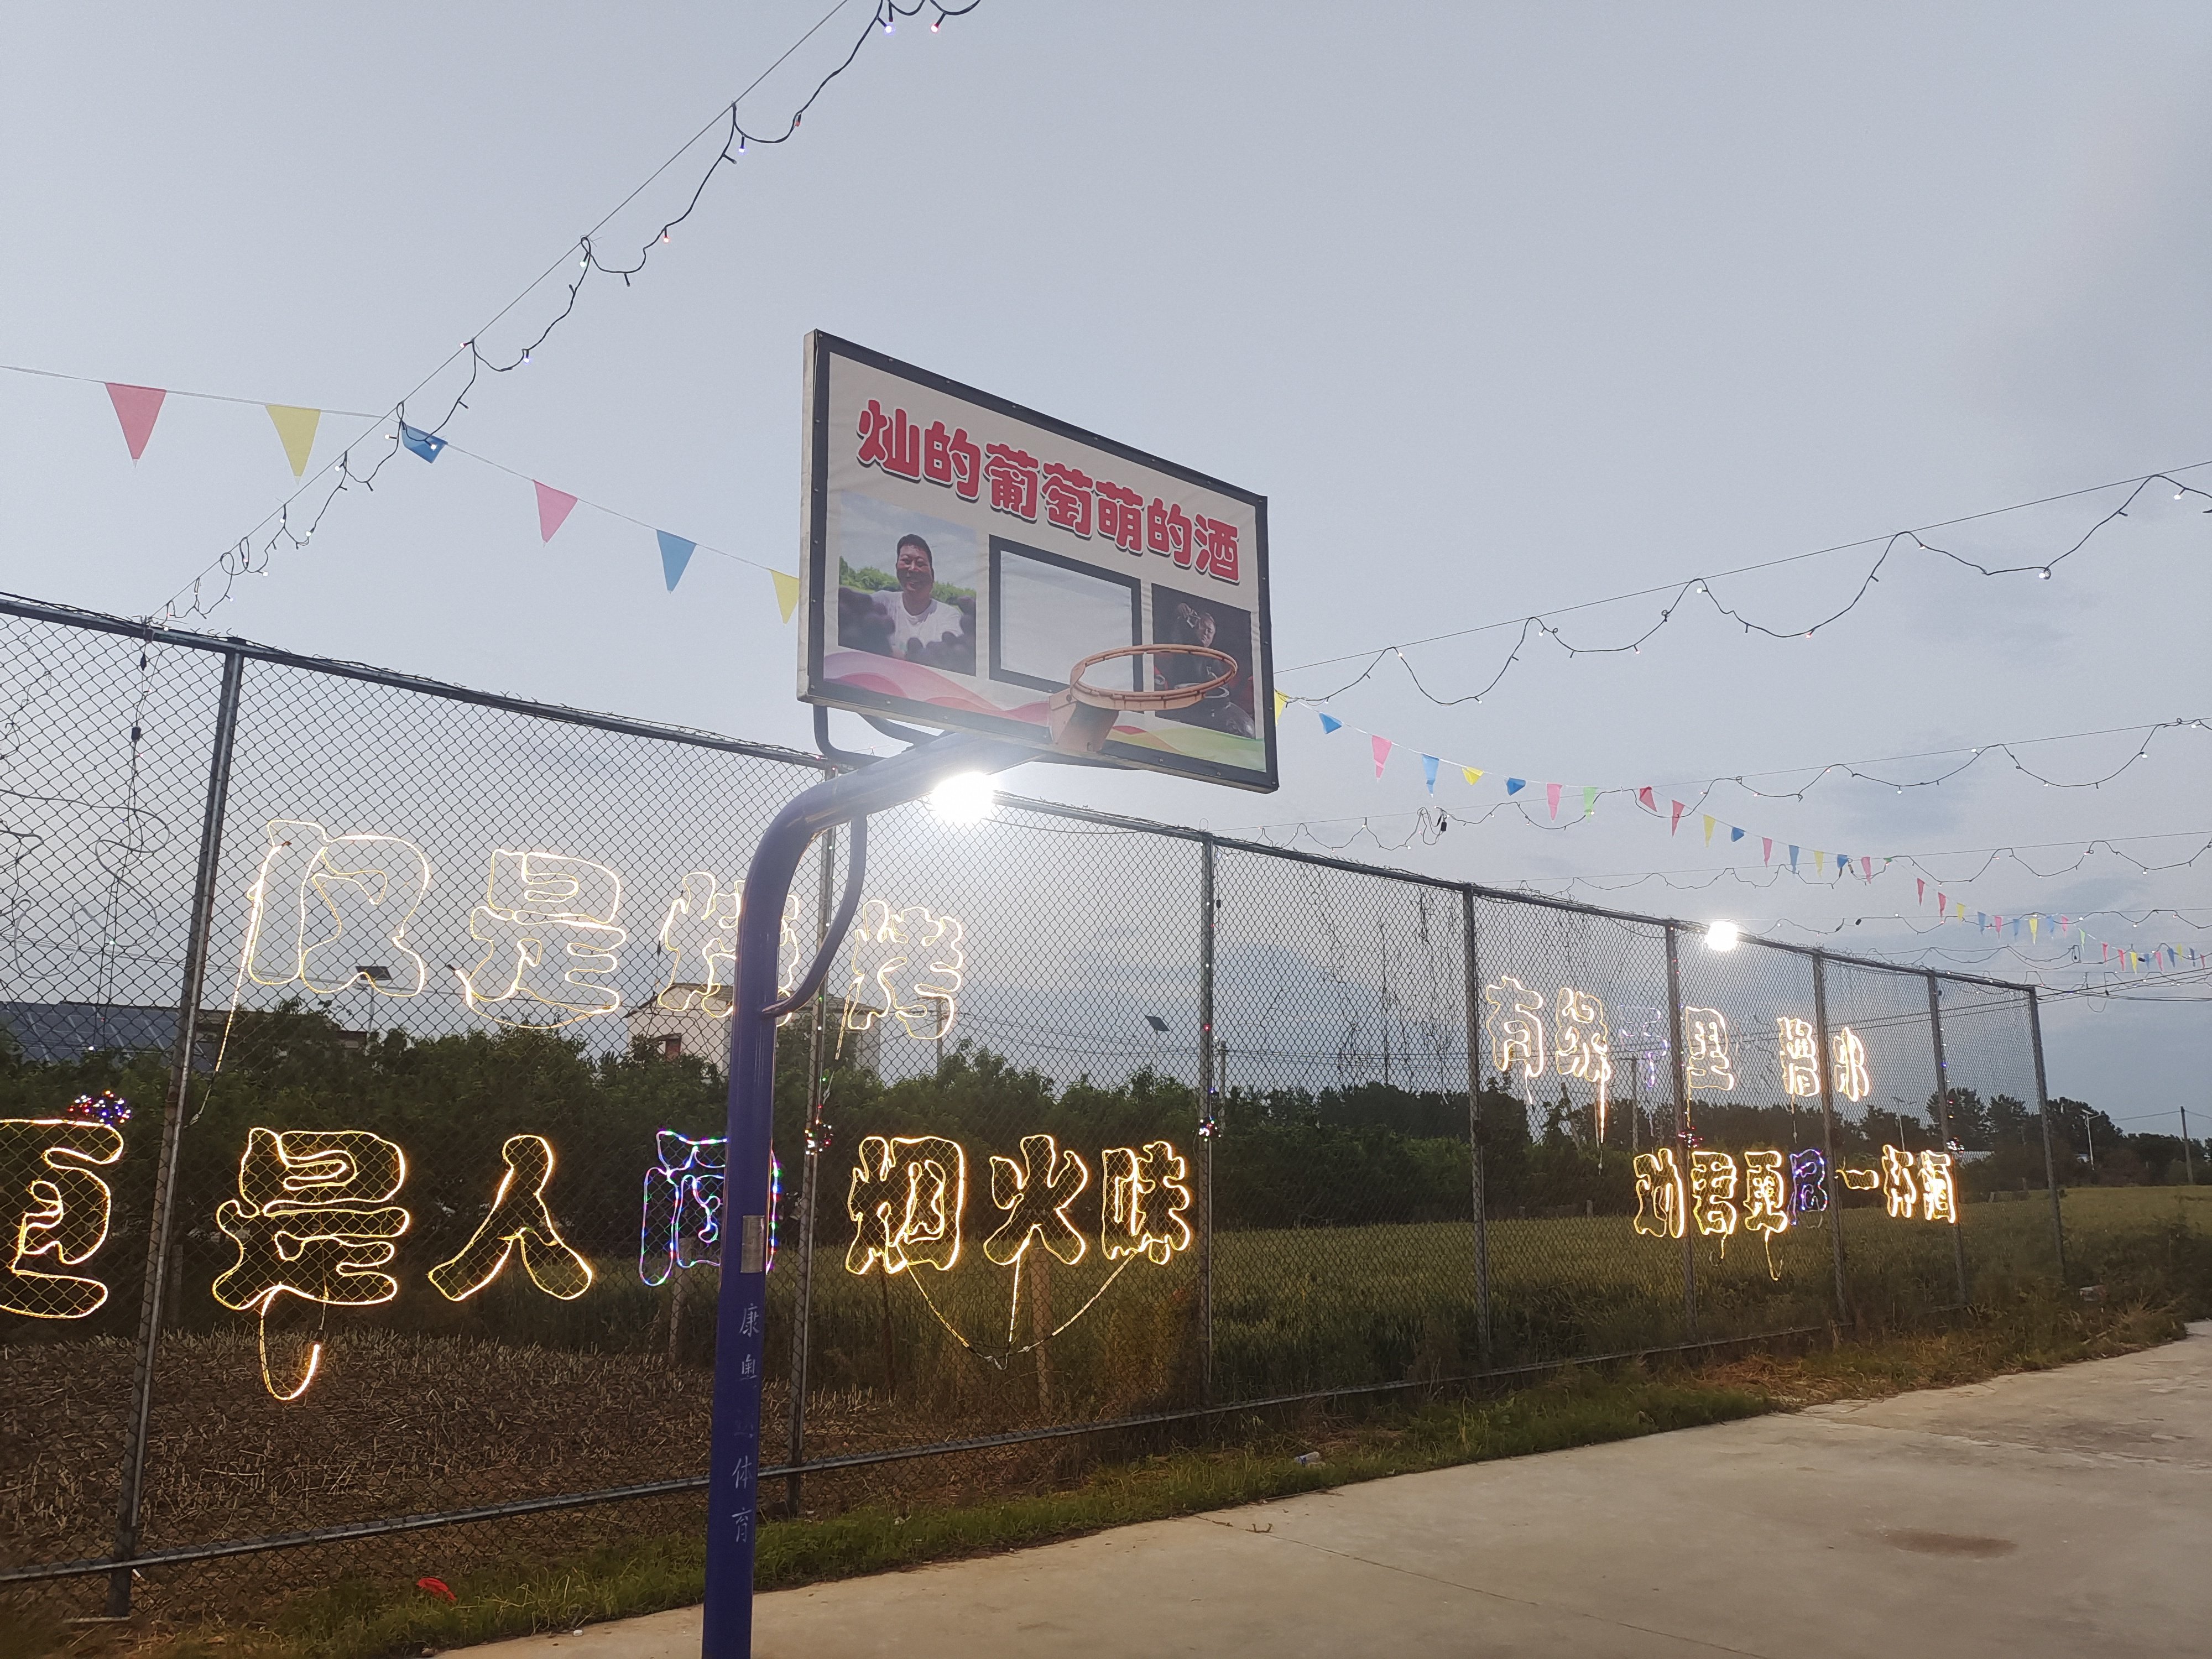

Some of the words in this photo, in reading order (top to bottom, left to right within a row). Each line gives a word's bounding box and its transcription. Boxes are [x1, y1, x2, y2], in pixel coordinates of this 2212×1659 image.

[856, 398, 1241, 584] 灿的葡萄萌的酒
[731, 1302, 760, 1543] 康奥体育
